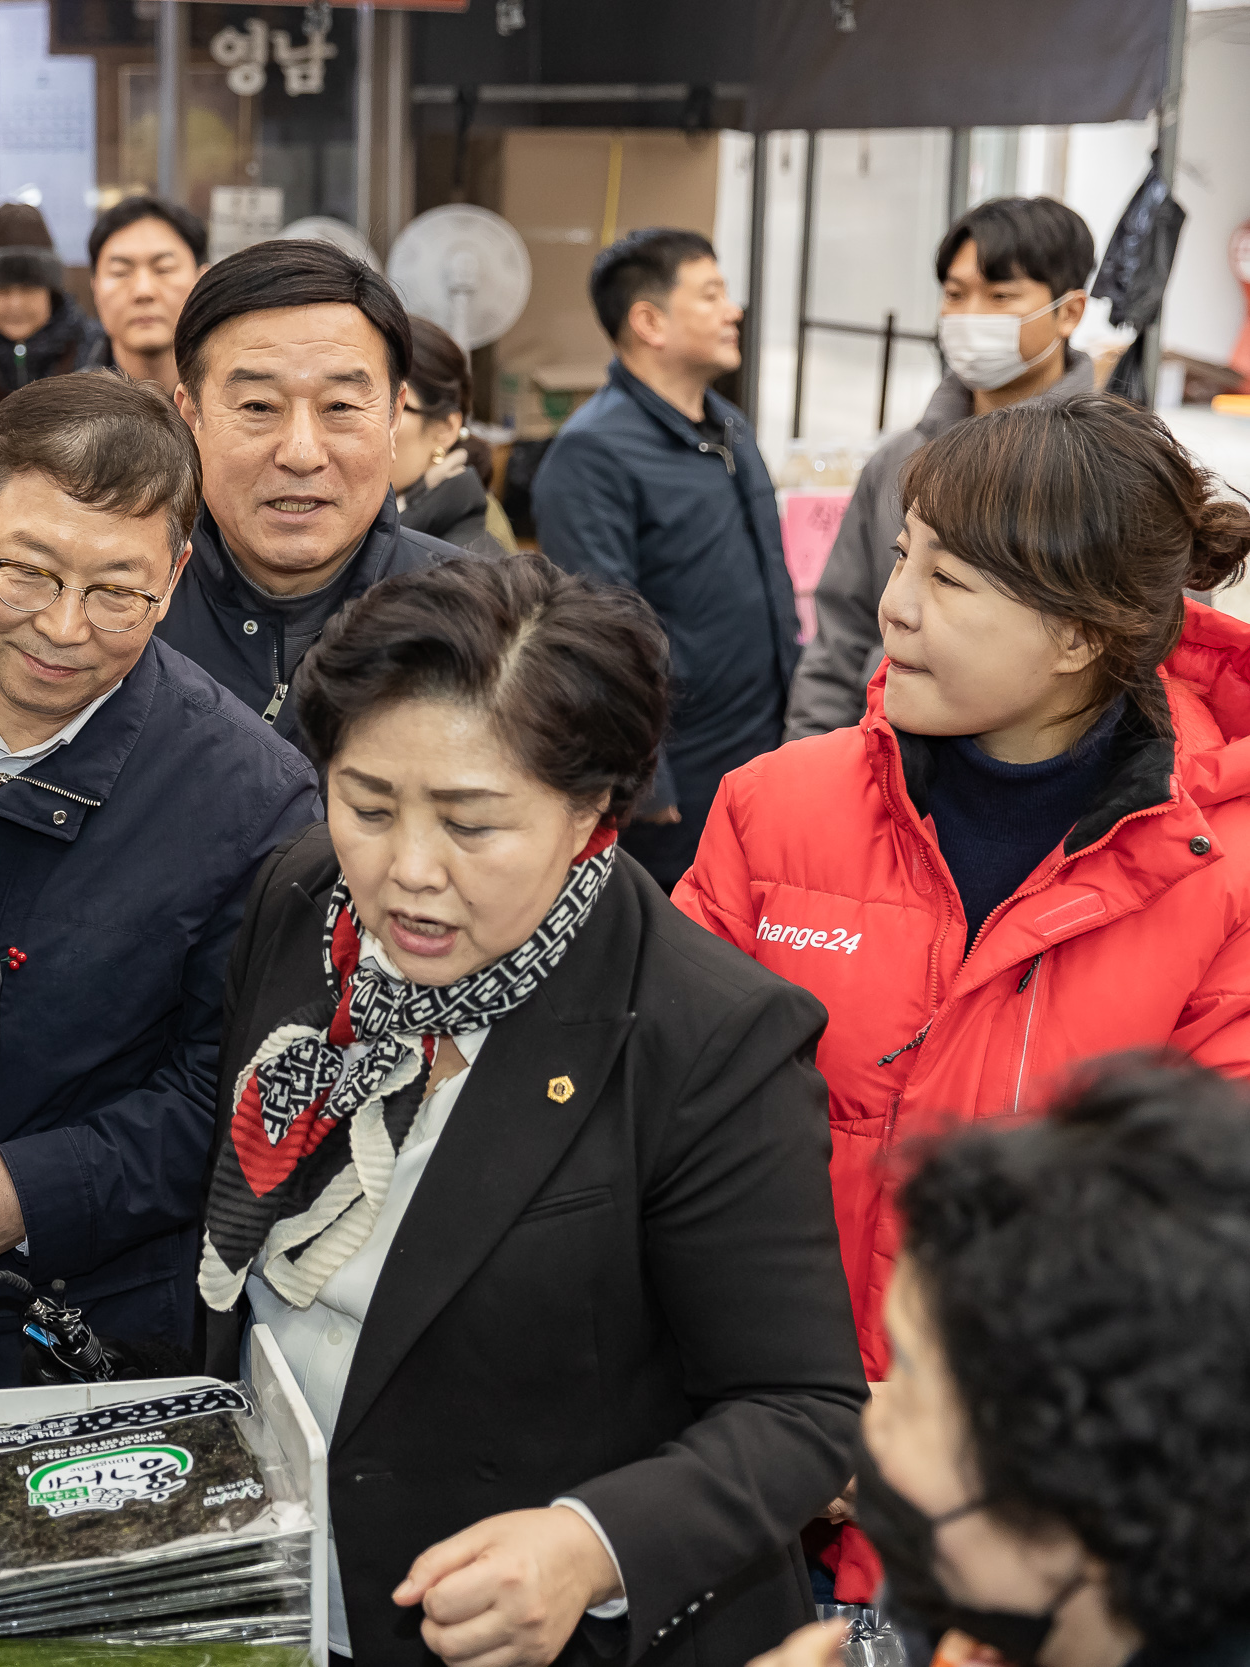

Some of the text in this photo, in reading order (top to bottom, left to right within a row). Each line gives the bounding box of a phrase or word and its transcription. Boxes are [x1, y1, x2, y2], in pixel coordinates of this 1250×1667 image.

[210, 17, 339, 97] 영남
[756, 916, 862, 955] hange24
[70, 1456, 137, 1473] Honggane
